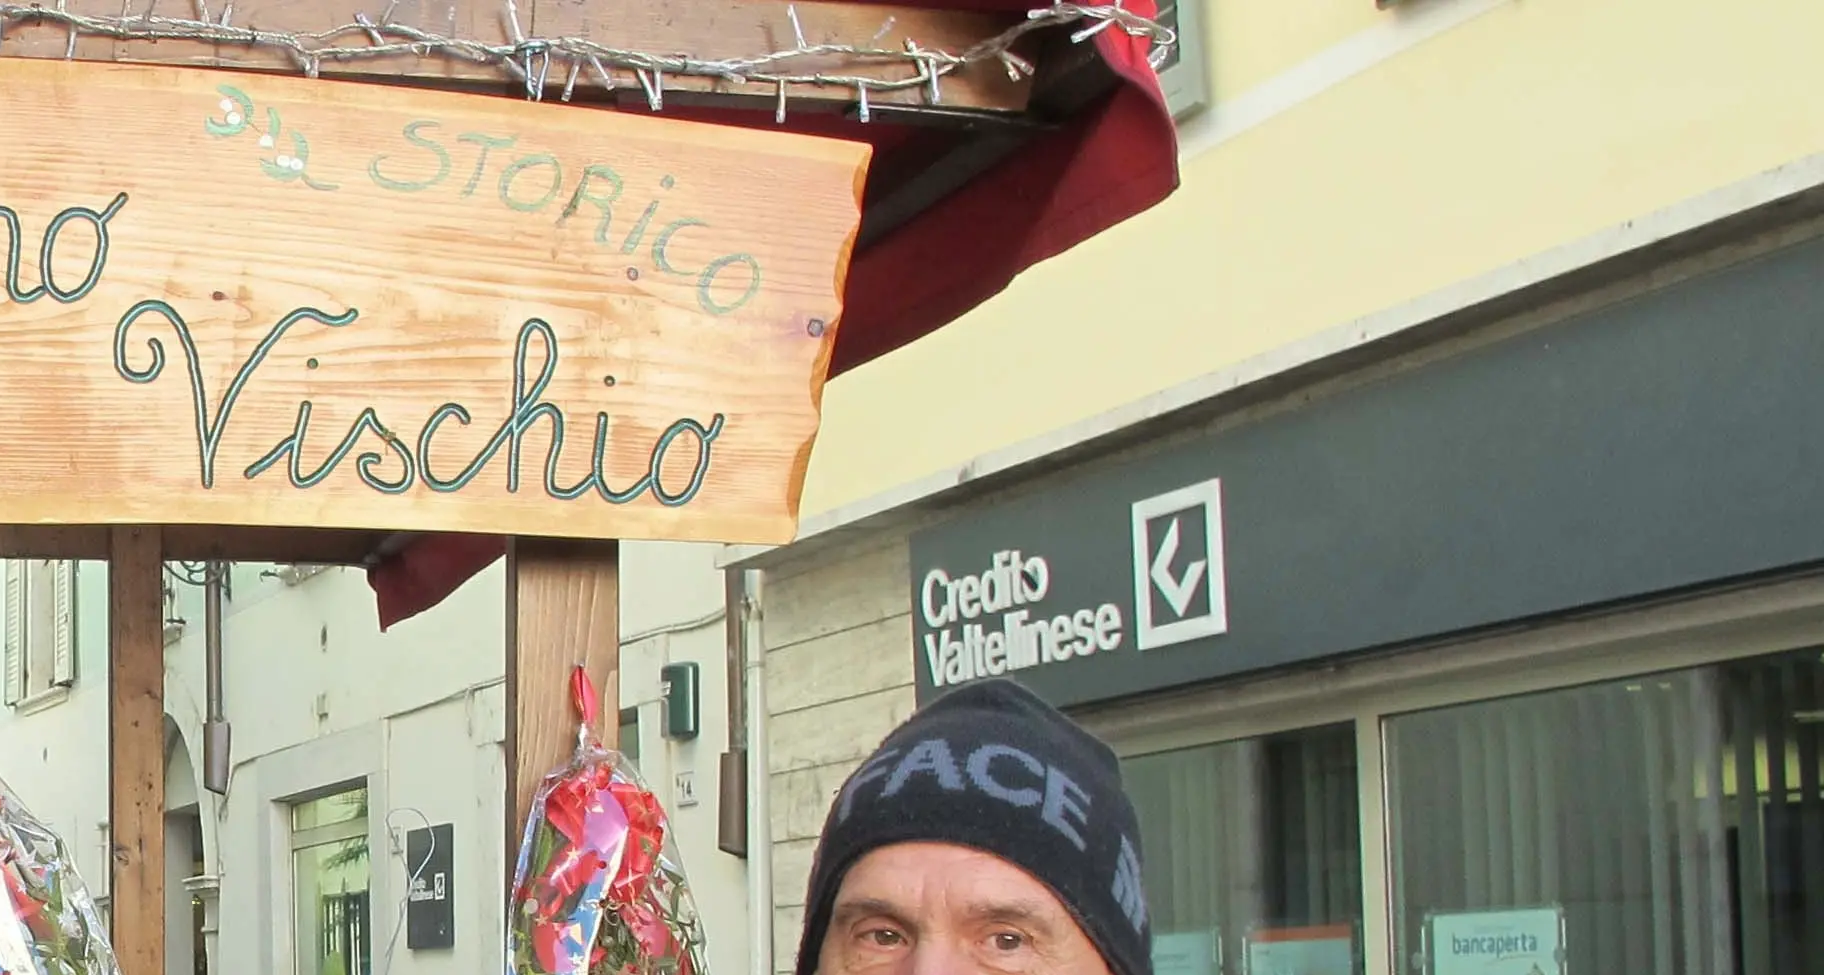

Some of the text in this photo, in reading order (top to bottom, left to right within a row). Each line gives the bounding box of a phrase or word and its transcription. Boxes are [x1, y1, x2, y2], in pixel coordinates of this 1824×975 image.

[114, 299, 725, 507] Vischio
[922, 549, 1049, 628] Credito
[924, 602, 1123, 687] Valtellinese
[838, 738, 1091, 852] FACE
[1452, 932, 1538, 958] bancaperta
